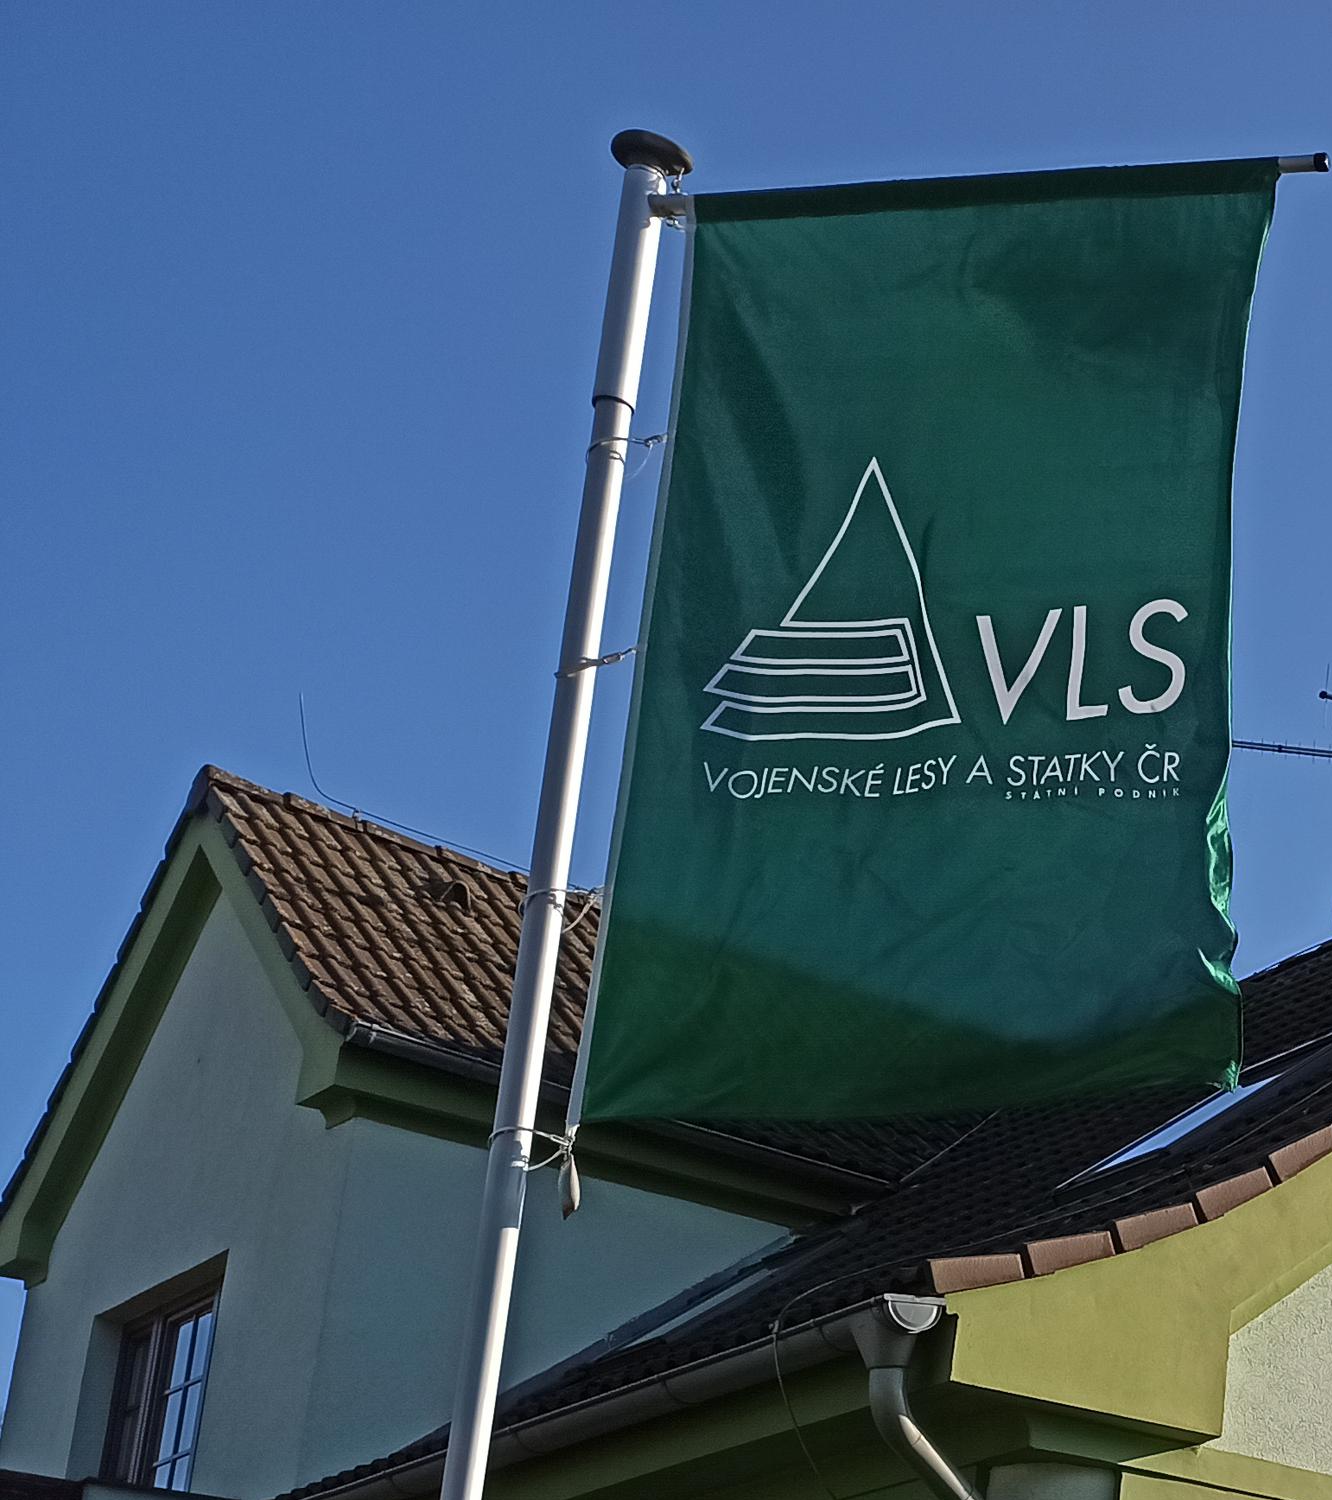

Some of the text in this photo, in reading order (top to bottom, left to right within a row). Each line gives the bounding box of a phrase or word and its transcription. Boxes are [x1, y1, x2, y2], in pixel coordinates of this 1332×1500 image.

[976, 598, 1189, 725] VLS
[703, 743, 1180, 799] VOJENSKÉ LESY A STATKY ČR
[1098, 787, 1180, 799] PODNIK
